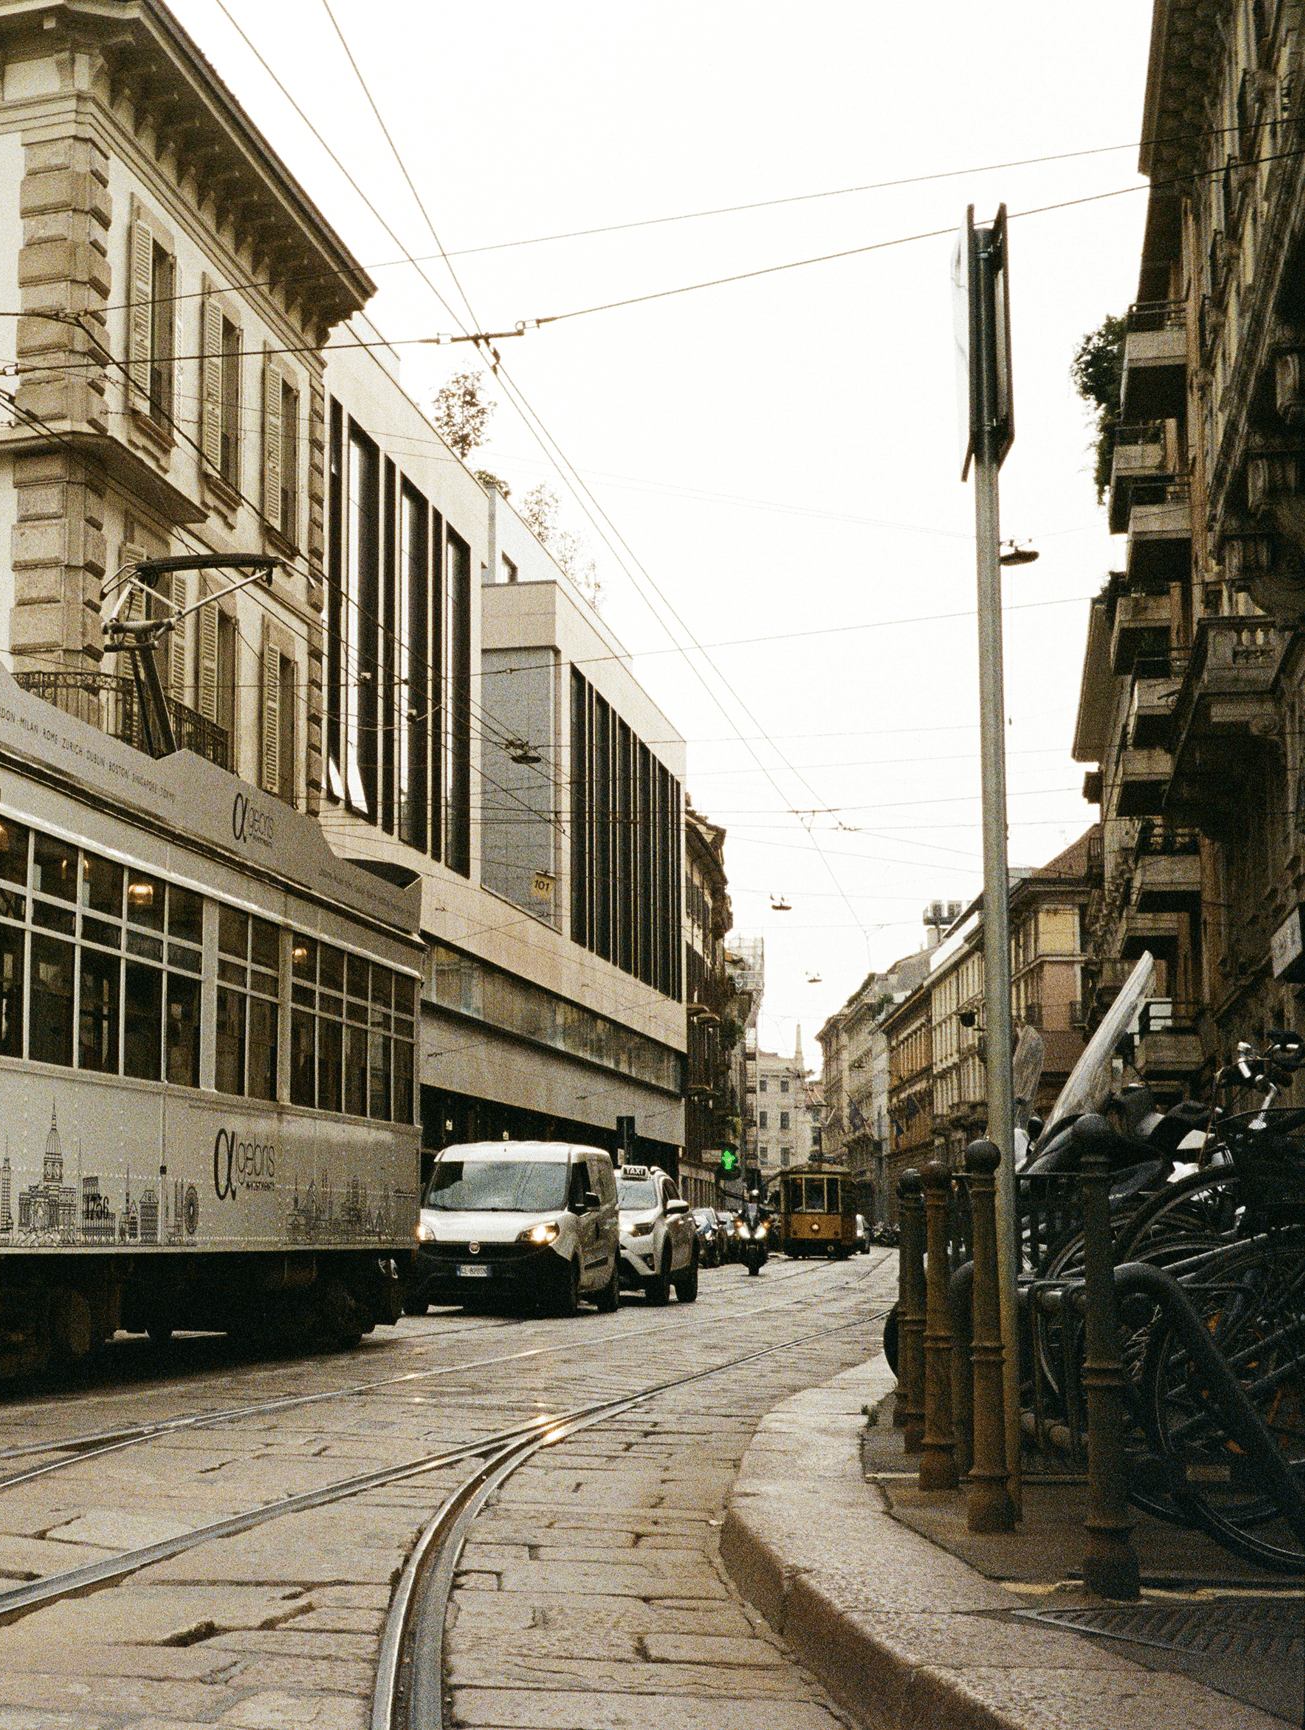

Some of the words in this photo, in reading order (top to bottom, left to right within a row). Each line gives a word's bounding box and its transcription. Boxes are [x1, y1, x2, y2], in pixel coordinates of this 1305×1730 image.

[535, 879, 550, 891] 101
[626, 1167, 645, 1176] TAXI
[86, 1195, 109, 1220] 1756
